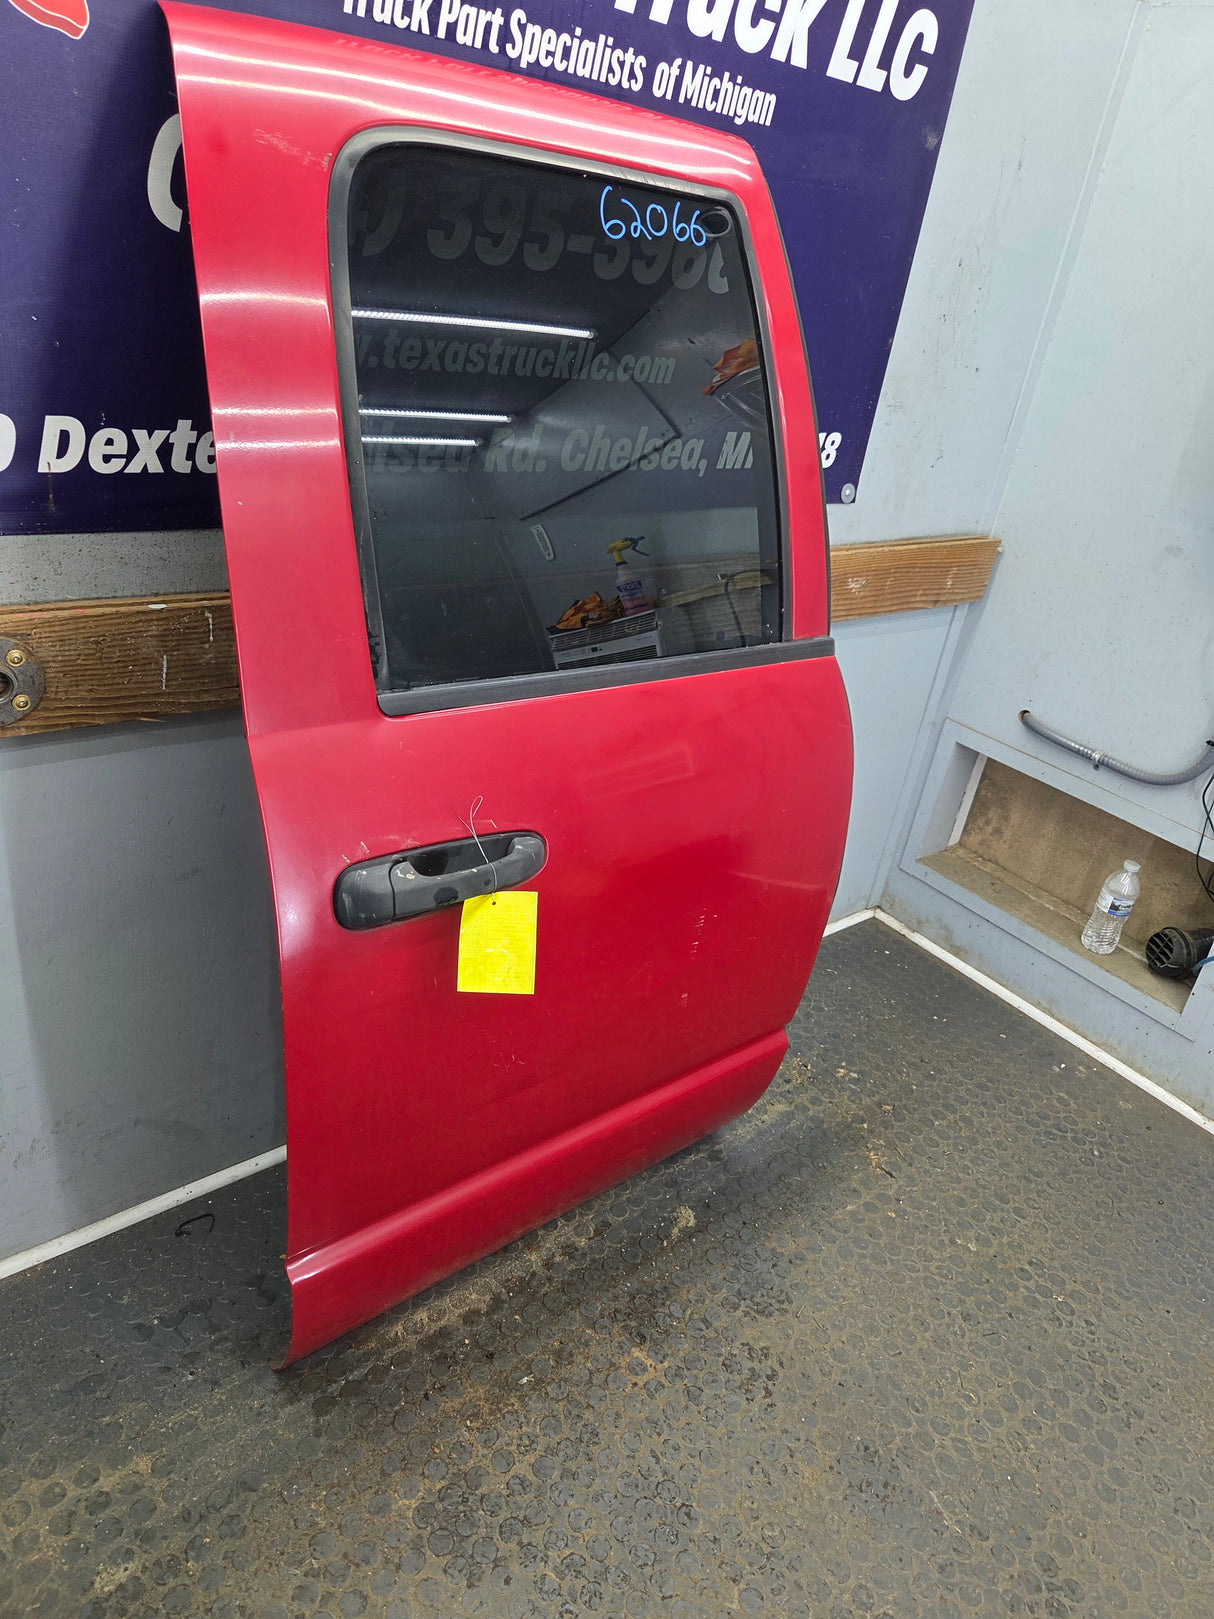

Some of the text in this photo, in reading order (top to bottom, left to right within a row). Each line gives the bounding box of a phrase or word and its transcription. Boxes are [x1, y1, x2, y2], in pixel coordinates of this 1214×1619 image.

[343, 0, 776, 127] uck Part Specialists of Michigan
[613, 0, 828, 70] uck
[599, 185, 708, 248] 62066
[483, 424, 547, 473] Rd.
[561, 425, 708, 477] Chelsea,
